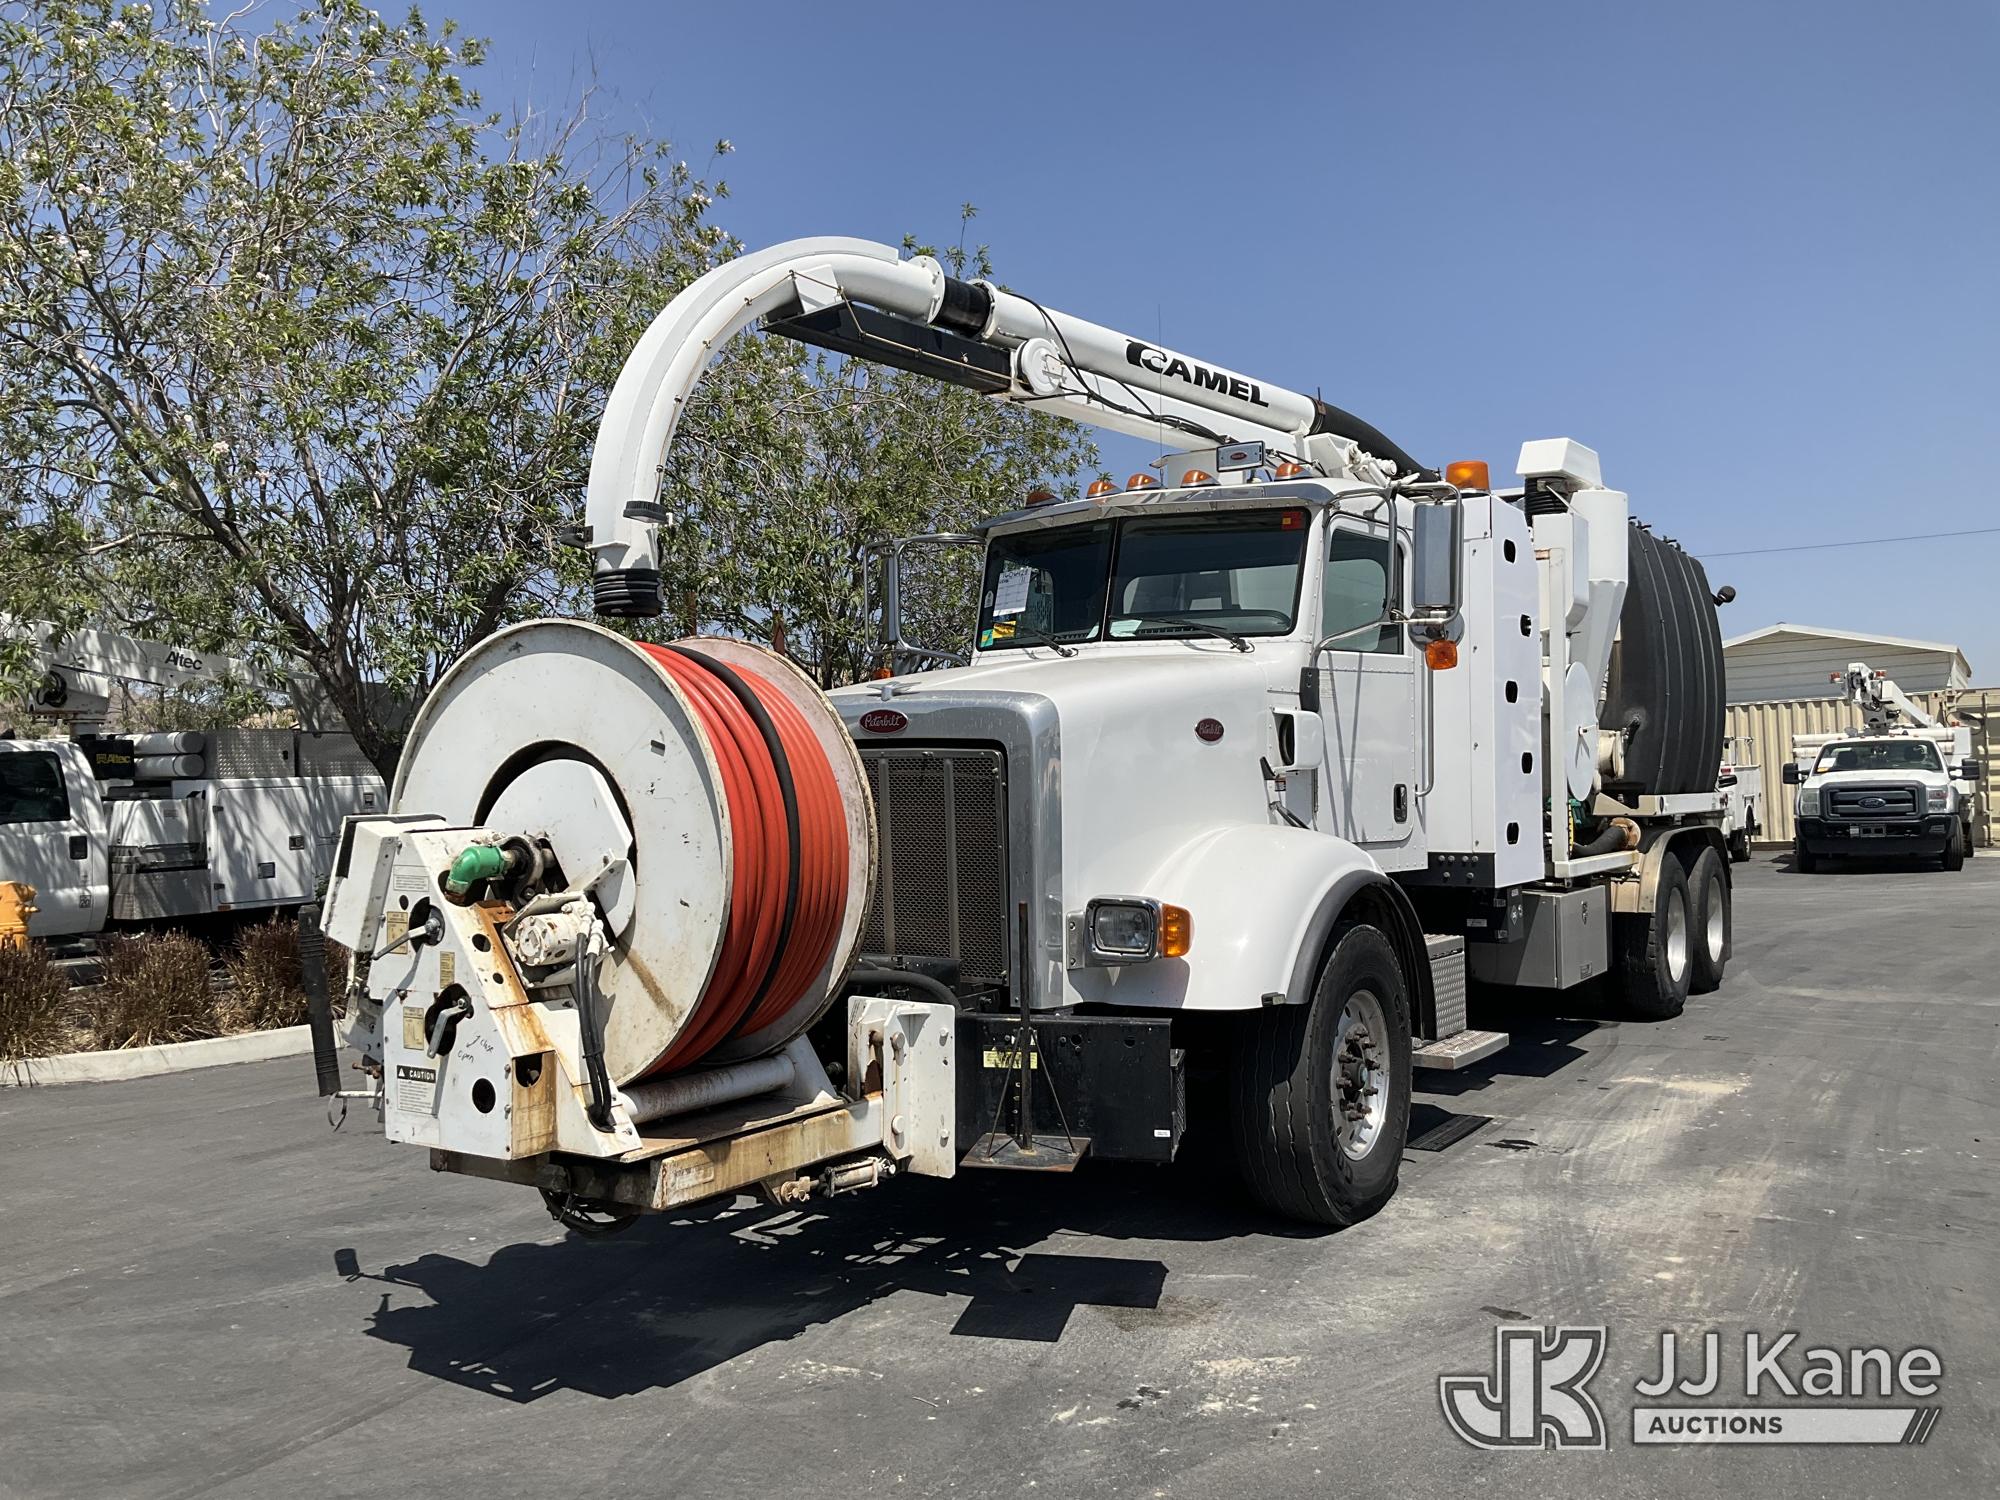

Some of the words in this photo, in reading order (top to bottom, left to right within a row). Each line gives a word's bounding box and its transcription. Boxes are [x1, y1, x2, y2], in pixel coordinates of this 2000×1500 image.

[1126, 339, 1269, 408] CAMEL
[164, 651, 203, 671] Altec
[865, 713, 902, 728] Peterbilt
[409, 1069, 435, 1081] CAUTION
